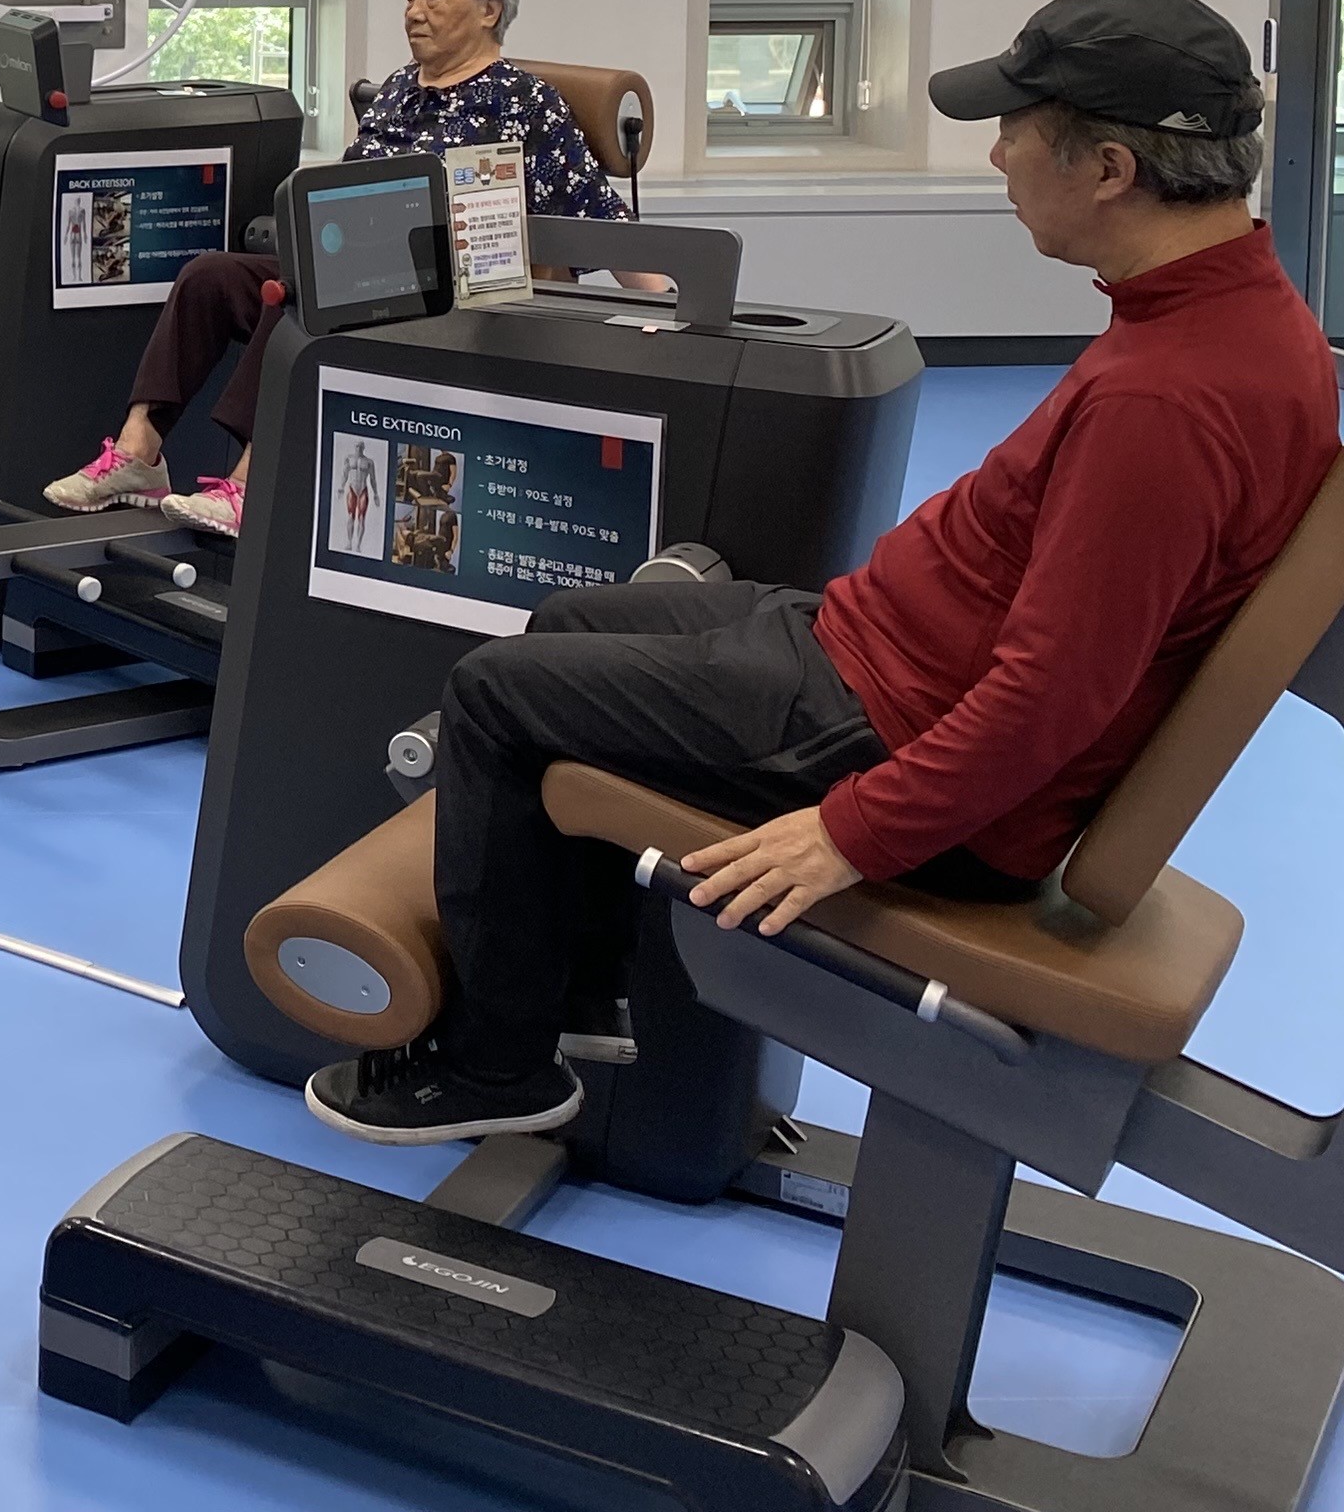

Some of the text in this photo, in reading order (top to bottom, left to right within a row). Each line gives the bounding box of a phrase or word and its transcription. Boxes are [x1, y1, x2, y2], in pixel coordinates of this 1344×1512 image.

[69, 180, 90, 189] BACK
[351, 411, 461, 441] LEG EXTENSION
[484, 454, 527, 473] 초기설정
[488, 482, 572, 508] 등받이 90도 설정
[486, 509, 516, 524] 시작점
[572, 524, 596, 537] 90도
[488, 548, 513, 564] 종료점
[538, 558, 564, 572] 올리고
[604, 571, 615, 583] 때
[517, 567, 534, 581] 없는
[557, 575, 583, 588] 100%
